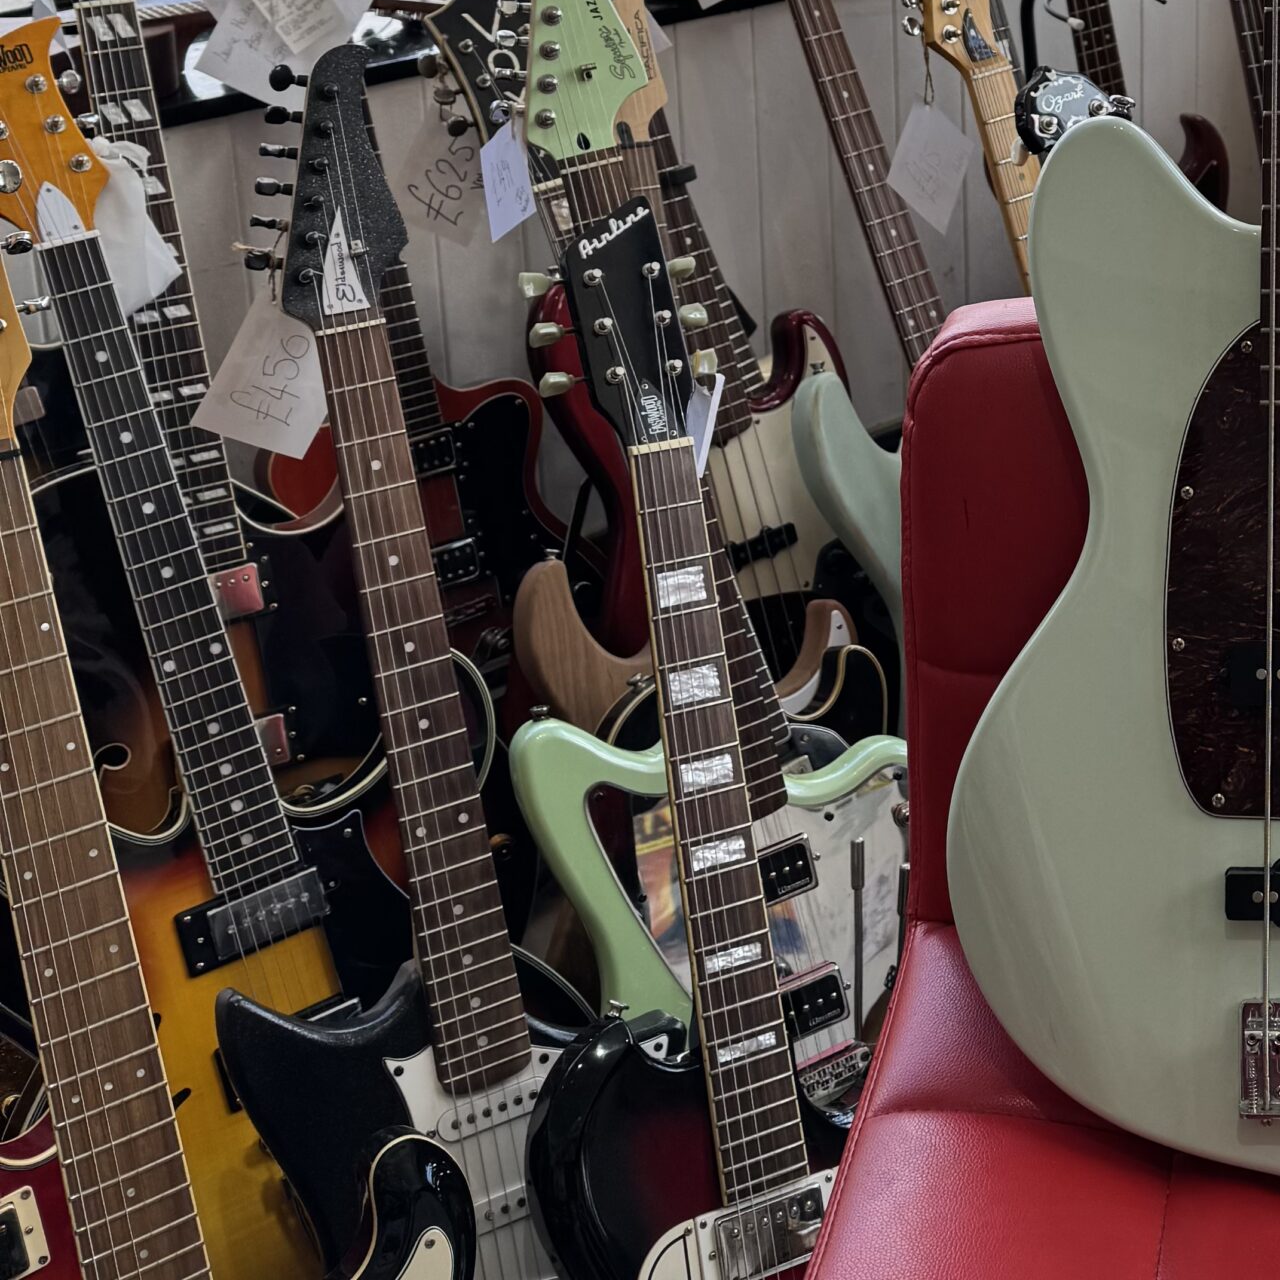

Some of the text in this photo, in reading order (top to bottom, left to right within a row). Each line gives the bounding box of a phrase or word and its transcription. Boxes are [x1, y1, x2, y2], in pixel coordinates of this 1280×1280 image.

[1041, 83, 1086, 113] Ozark
[407, 144, 475, 226] £625
[578, 206, 650, 260] Airline
[229, 334, 311, 427] £450
[641, 395, 667, 435] EASTWOOD
